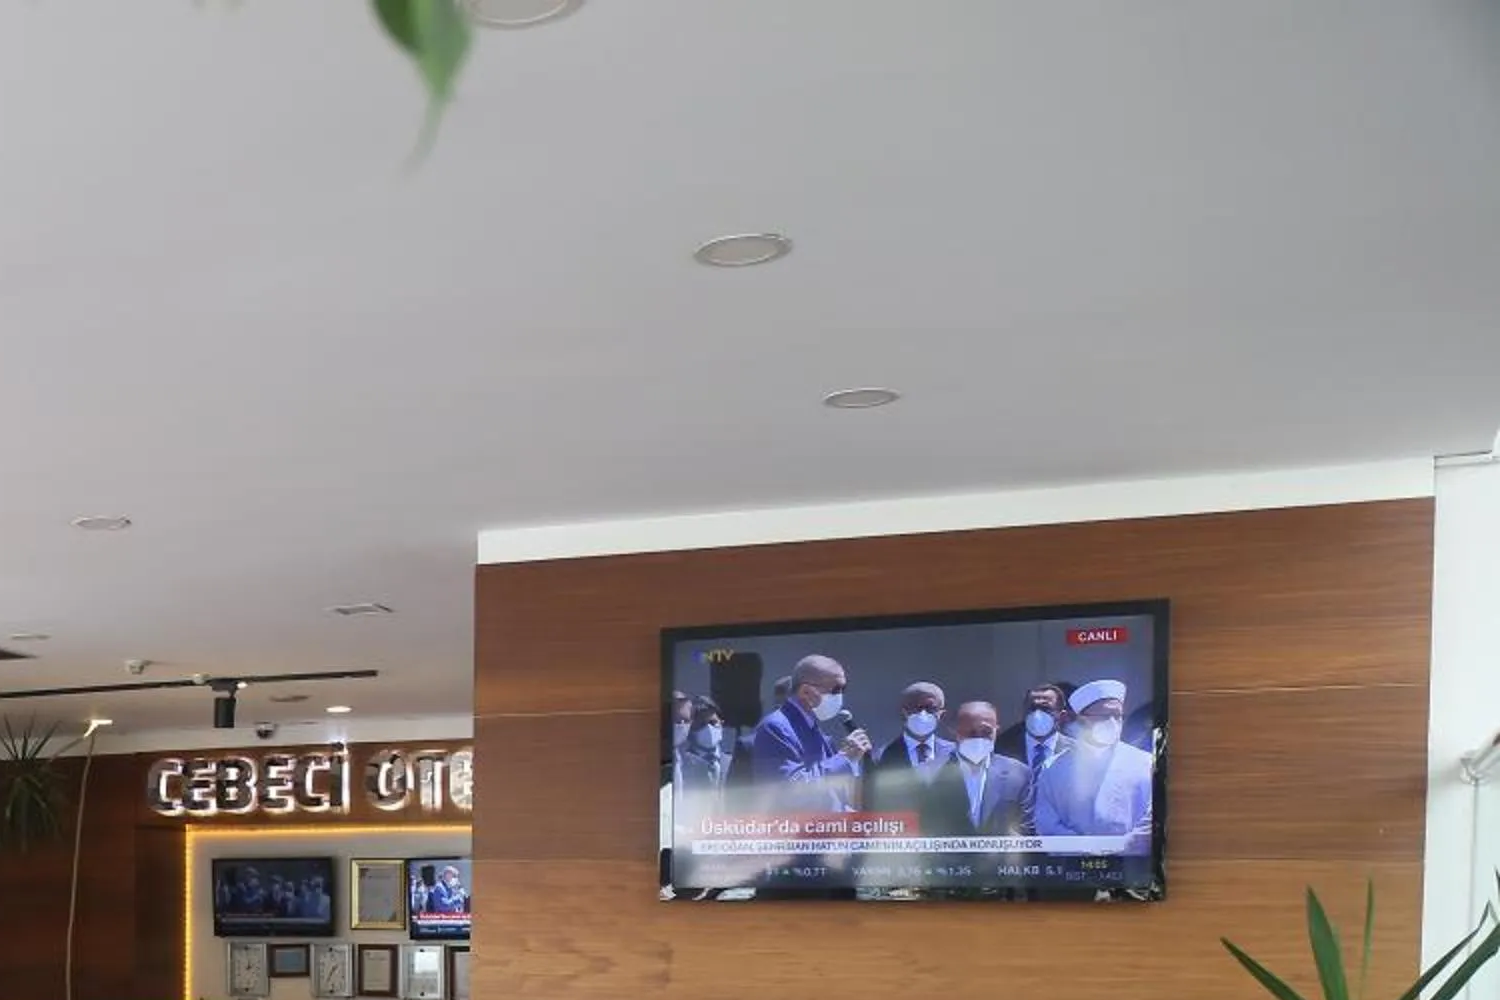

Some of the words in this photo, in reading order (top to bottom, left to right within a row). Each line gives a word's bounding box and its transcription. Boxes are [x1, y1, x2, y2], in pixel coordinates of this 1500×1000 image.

[1077, 630, 1117, 641] CANLI
[149, 740, 350, 817] CEBECİ
[700, 817, 800, 836] Üsküdar'da
[804, 818, 847, 834] cami
[851, 817, 905, 837] açılışı
